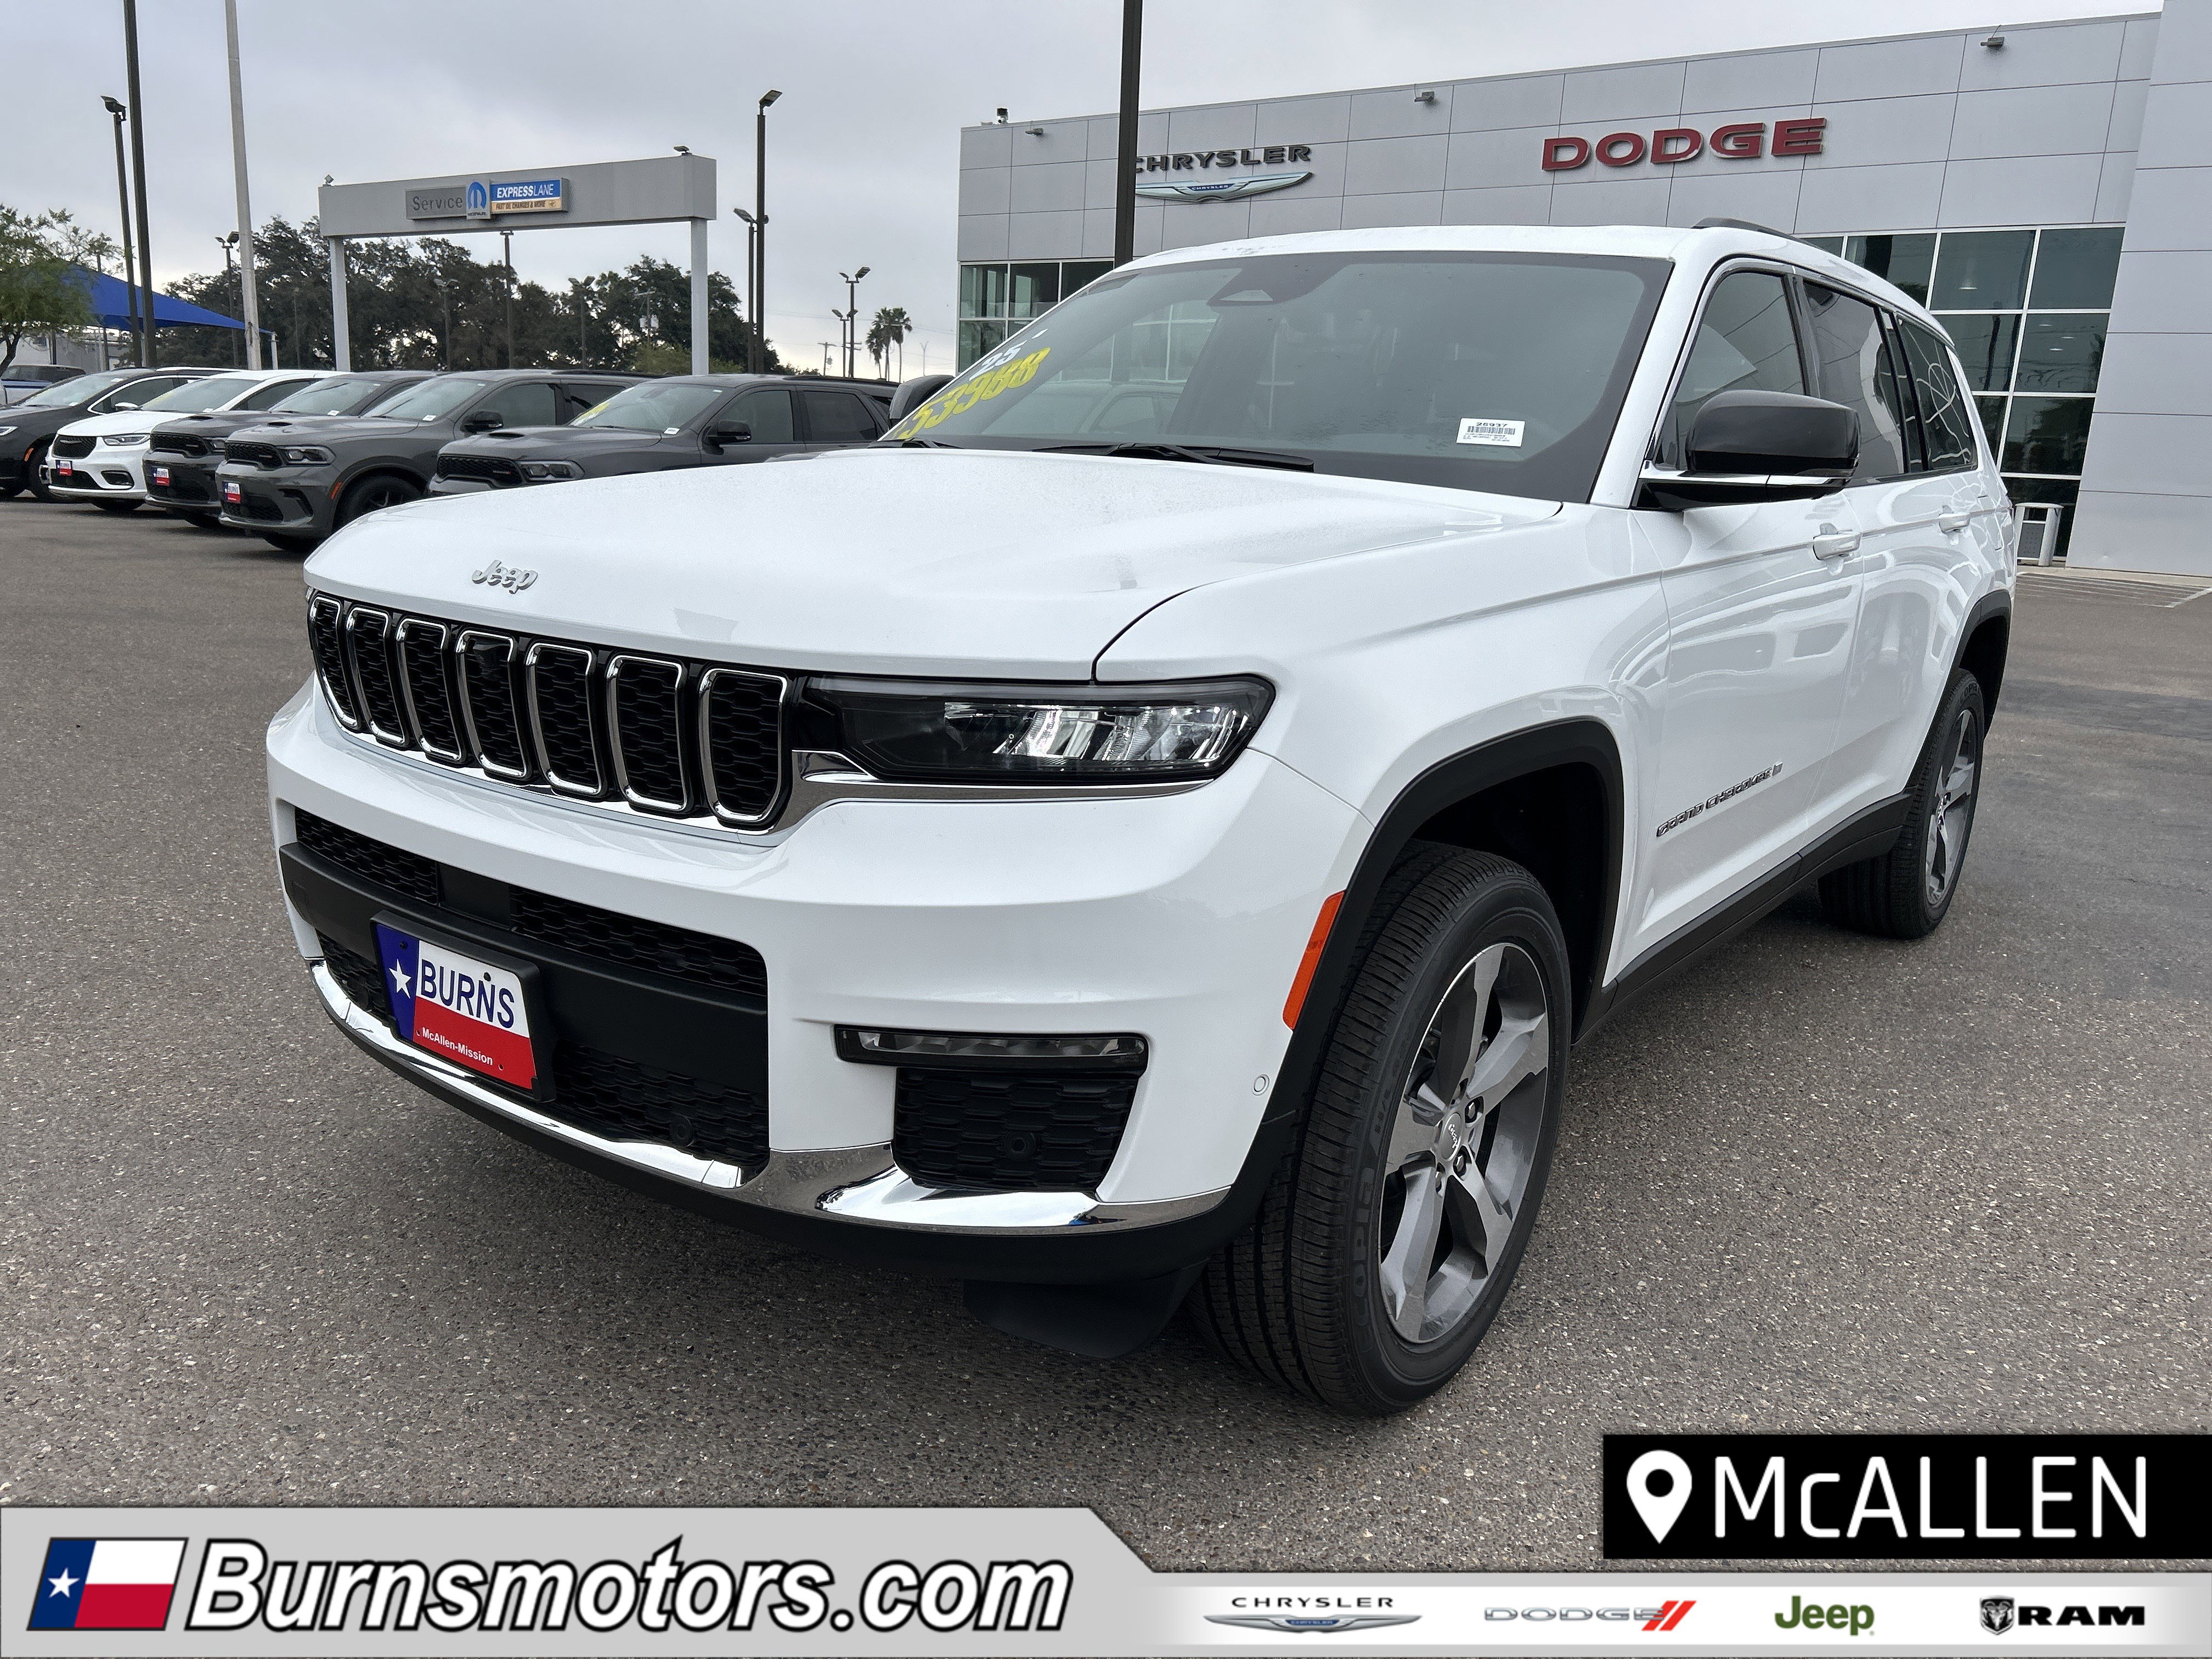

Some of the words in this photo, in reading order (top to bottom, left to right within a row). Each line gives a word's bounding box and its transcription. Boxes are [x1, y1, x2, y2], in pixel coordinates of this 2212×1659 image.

[1542, 117, 1827, 171] DODGE
[413, 196, 463, 211] Service
[472, 560, 538, 594] Jeep
[1656, 802, 1705, 837] GRAND
[1706, 767, 1773, 809] CHEROKEE
[421, 958, 515, 1029] BURNS
[422, 1026, 493, 1065] McAllen-Mission
